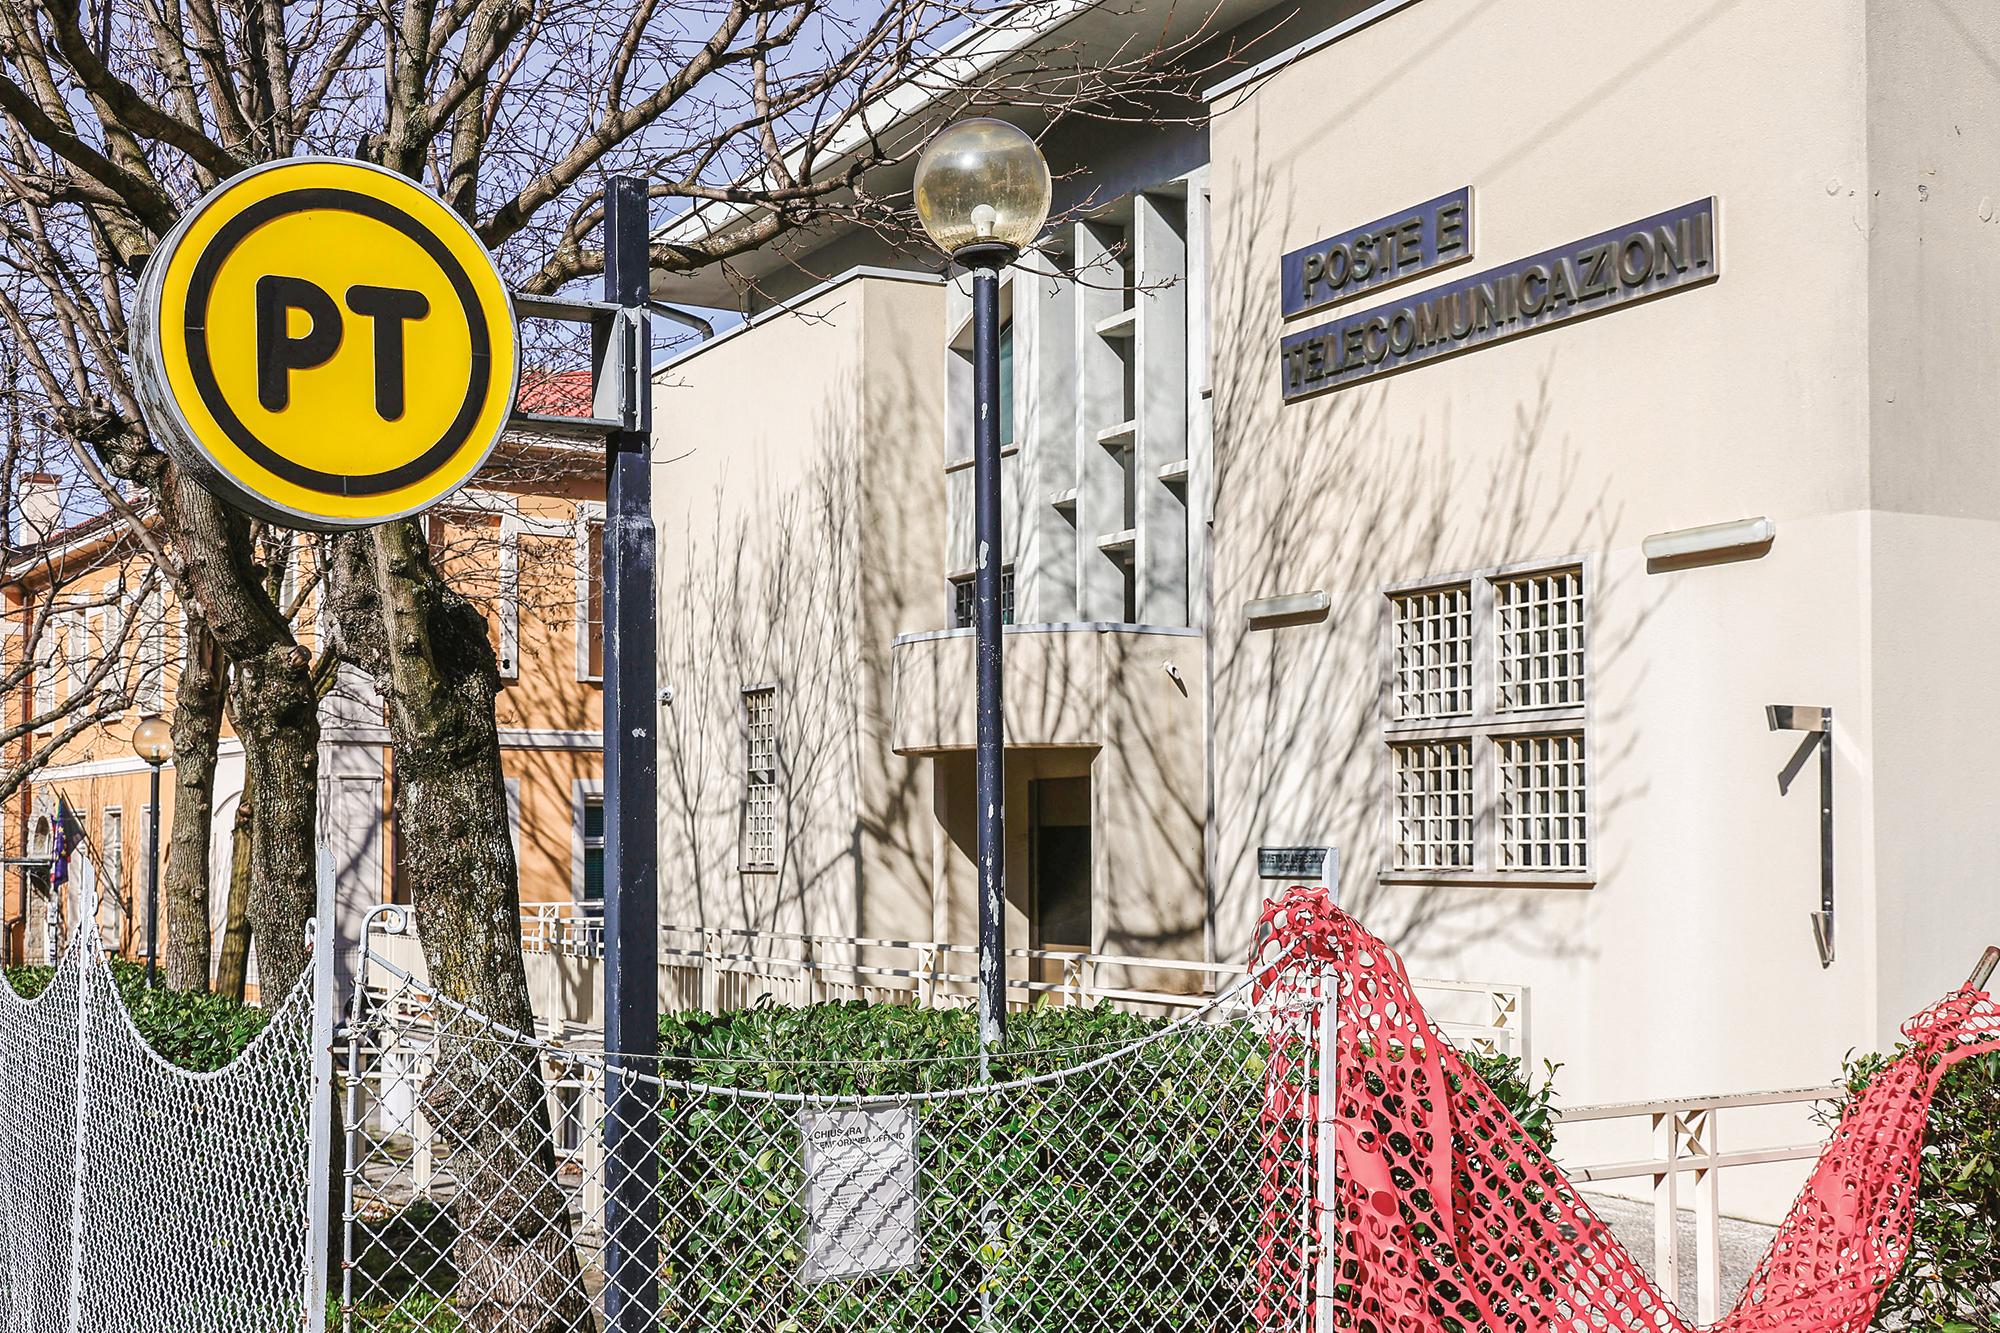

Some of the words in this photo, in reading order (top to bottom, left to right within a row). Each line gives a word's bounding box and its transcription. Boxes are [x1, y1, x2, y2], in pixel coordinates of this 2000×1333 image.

[1283, 211, 1711, 387] TELECOMUNICAZIONI
[1303, 215, 1423, 299] POSTE
[1435, 200, 1465, 254] E
[255, 274, 430, 422] PT
[814, 1127, 862, 1139] CHIUSRA
[814, 1136, 871, 1150] EMORNEA
